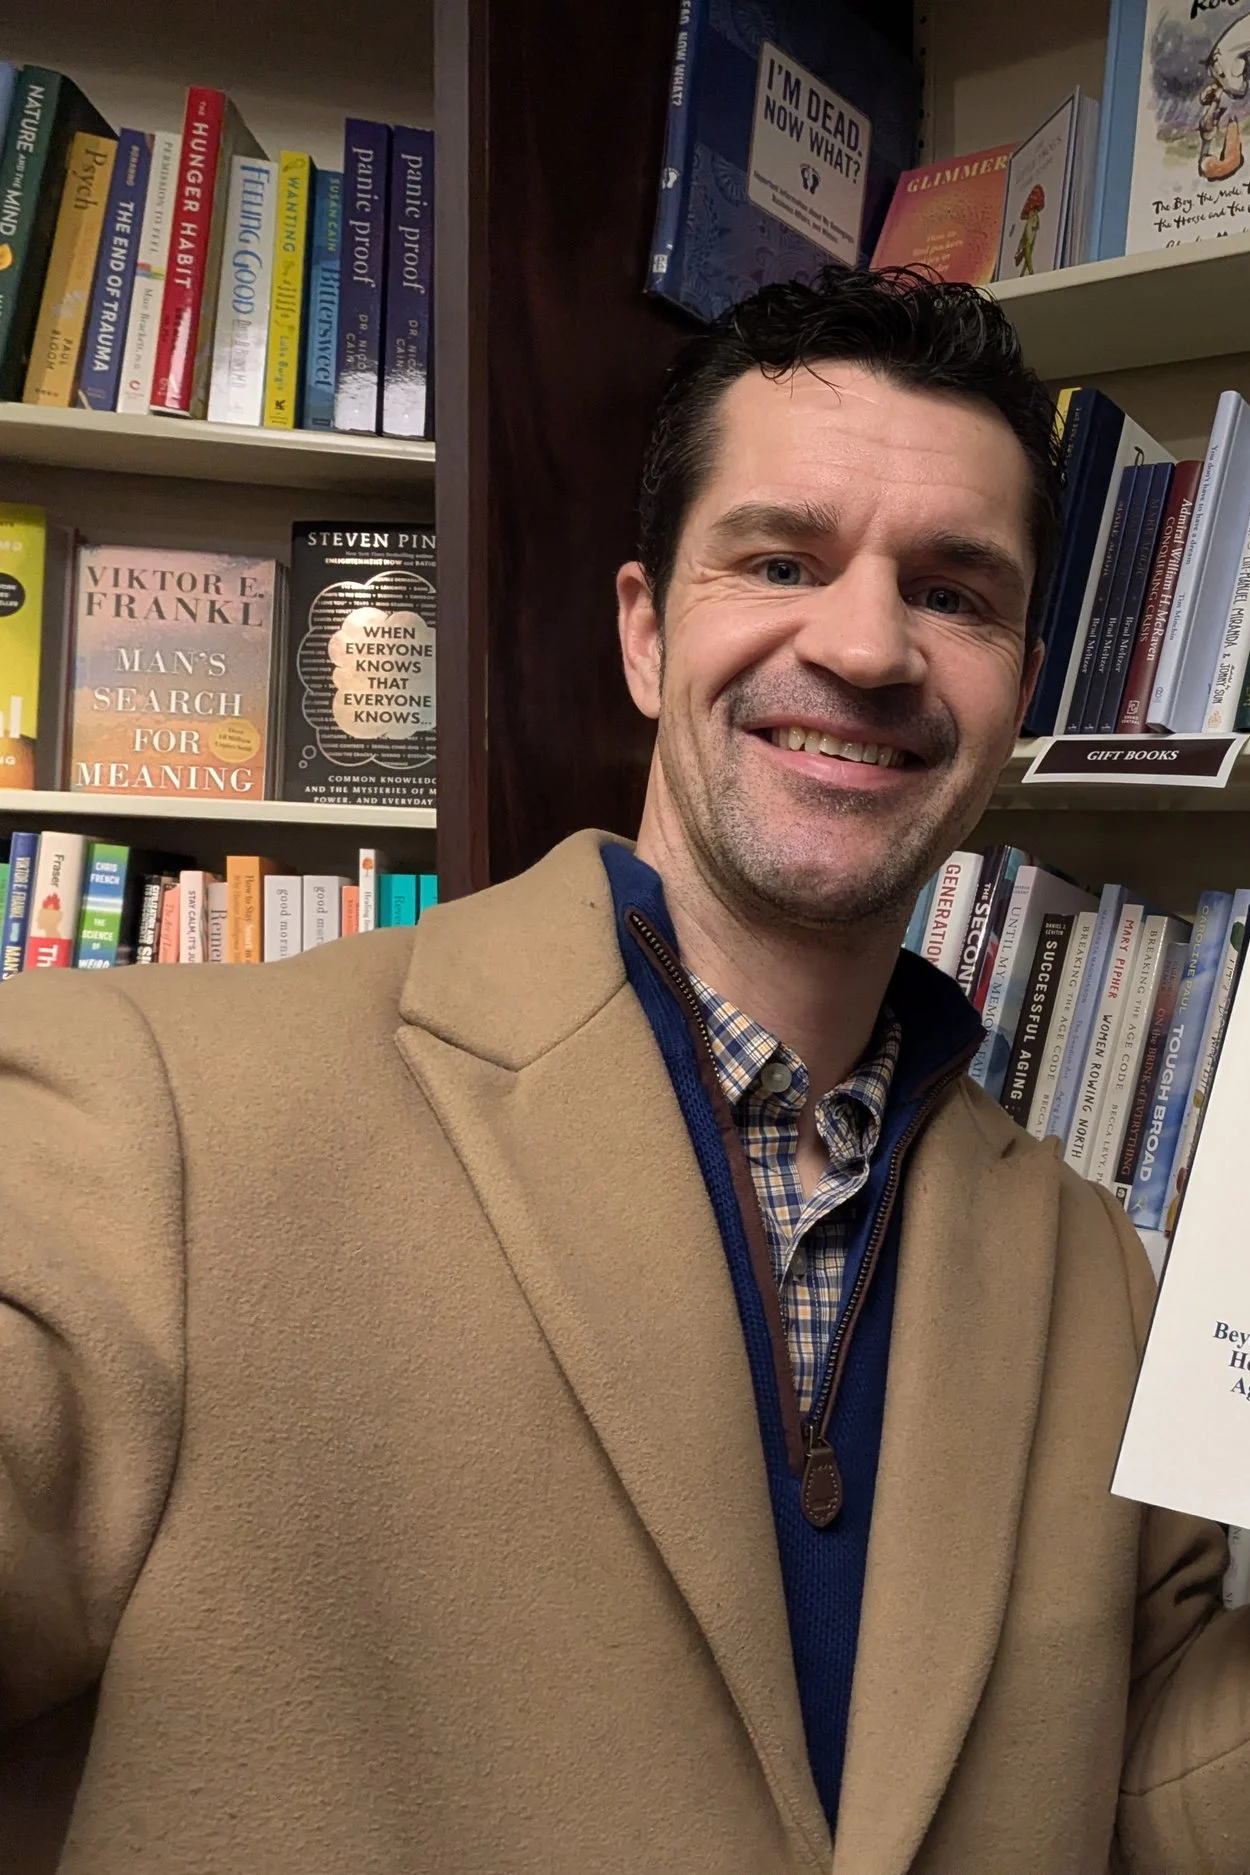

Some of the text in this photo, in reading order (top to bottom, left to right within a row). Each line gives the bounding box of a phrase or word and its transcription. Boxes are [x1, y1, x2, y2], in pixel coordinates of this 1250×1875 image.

[767, 58, 862, 158] I'M DEAD.
[764, 95, 861, 184] NOW WHAT?
[72, 148, 108, 210] Psych
[174, 122, 209, 289] HUNGER HABIT
[282, 177, 299, 253] WANTING
[351, 147, 376, 289] panic proof
[93, 201, 135, 372] THE END OF TRAUMA
[313, 265, 340, 389] Bittersweet
[308, 532, 389, 548] STEVEN
[85, 566, 265, 599] VIKTOR E.
[85, 591, 264, 628] FRANKL
[364, 626, 416, 640] WHEN
[115, 647, 226, 677] MAN'S
[345, 642, 433, 657] EVERYONE
[355, 659, 422, 674] KNOWS
[367, 677, 409, 690] THAT
[93, 686, 243, 717] SEARCH
[343, 693, 432, 708] EVERYONE
[353, 710, 432, 725] KNOWS...
[134, 728, 200, 755] FOR
[1087, 749, 1180, 761] GIFT BOOKS
[76, 762, 255, 793] MEANING
[50, 854, 65, 888] Fraser
[90, 873, 120, 886] FRENCH
[96, 862, 118, 873] CHRIS
[82, 930, 114, 942] SCIENCE
[1010, 941, 1057, 1101] SUCCESSFUL AGING
[1071, 920, 1135, 1158] MARY PIPHER WOMEN ROWING NORTH
[1139, 1025, 1185, 1183] TOUGH BROAD
